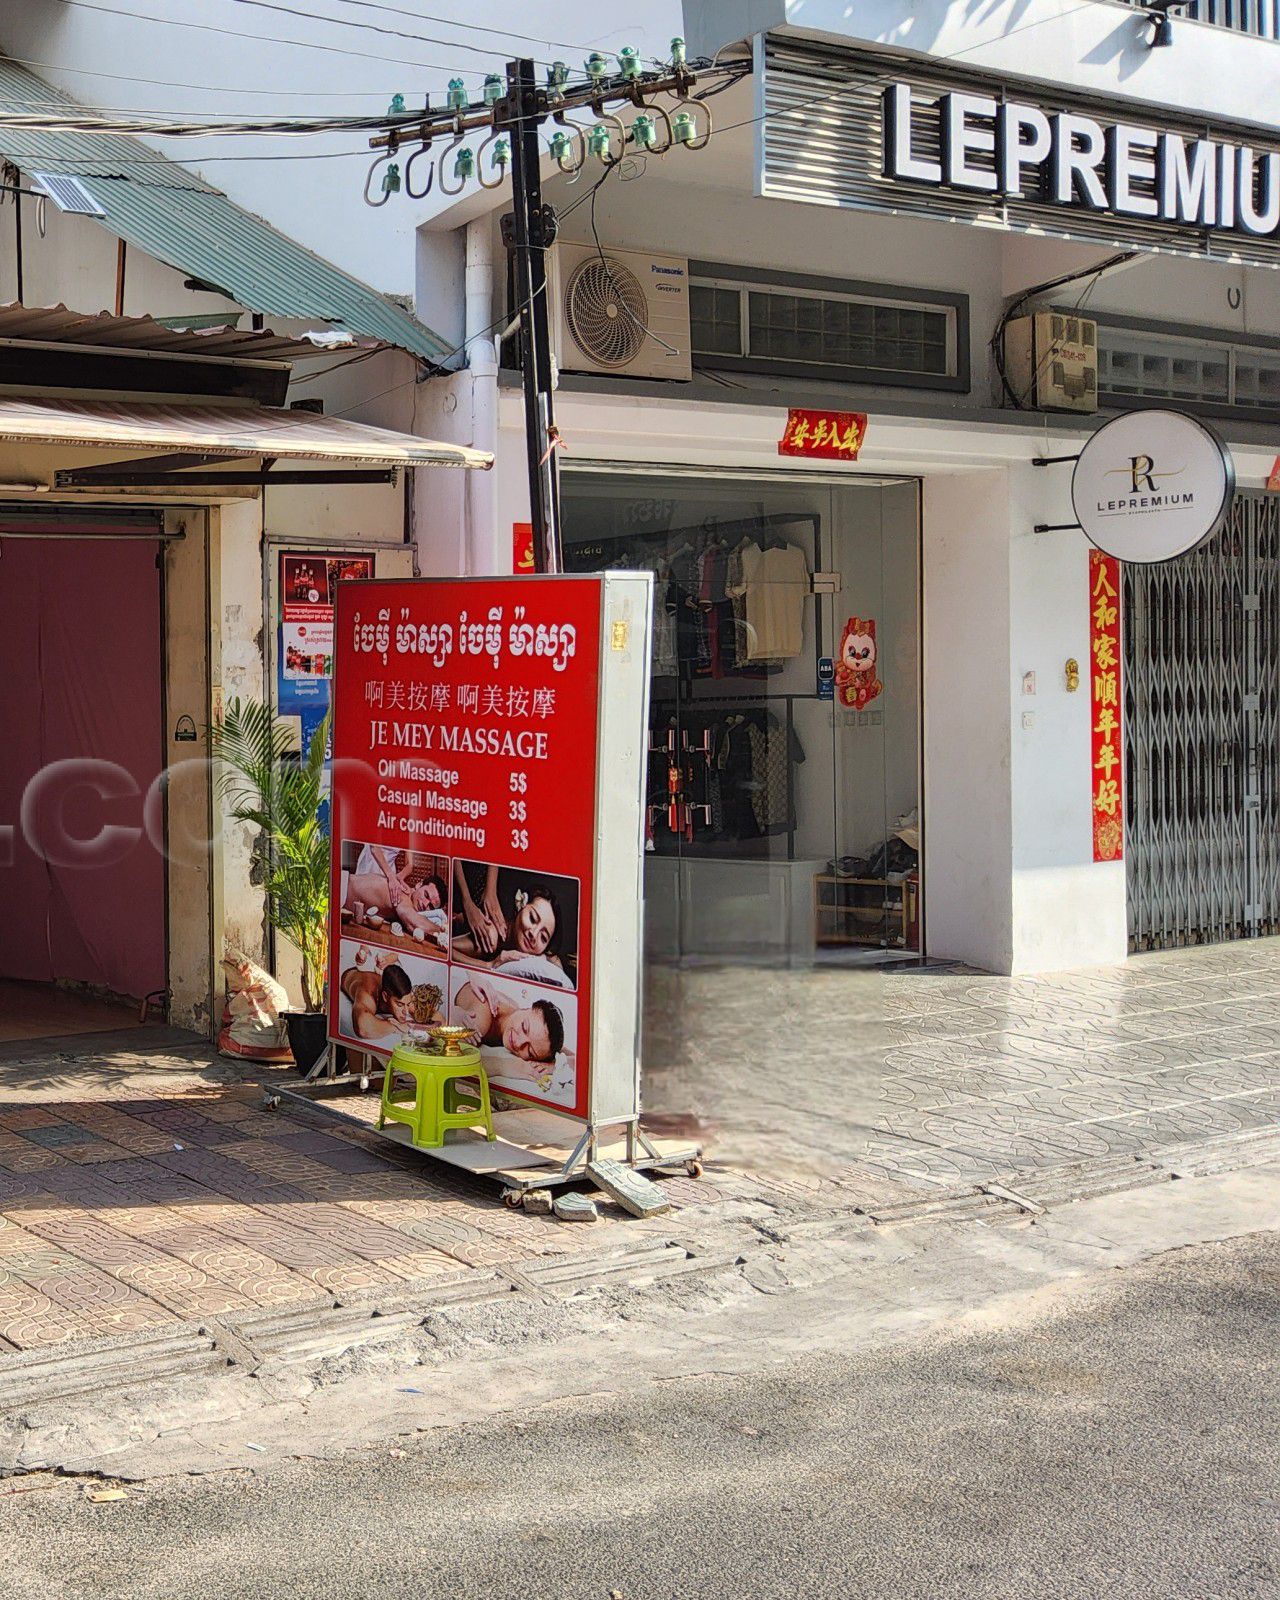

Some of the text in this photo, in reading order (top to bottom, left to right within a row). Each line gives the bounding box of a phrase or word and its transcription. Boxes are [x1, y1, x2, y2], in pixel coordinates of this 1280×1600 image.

[888, 83, 1280, 235] LEPREMIU
[651, 264, 684, 276] Panasonic
[1097, 493, 1194, 512] LEPREMIUM
[365, 680, 556, 719] 啊美按摩 啊美按摩
[370, 720, 548, 760] JE MEY MASSAGE
[400, 761, 459, 789] Massage
[509, 771, 528, 795] 5$
[377, 784, 527, 823] Casual Massage 3$
[377, 810, 529, 851] Air conditioning 3$
